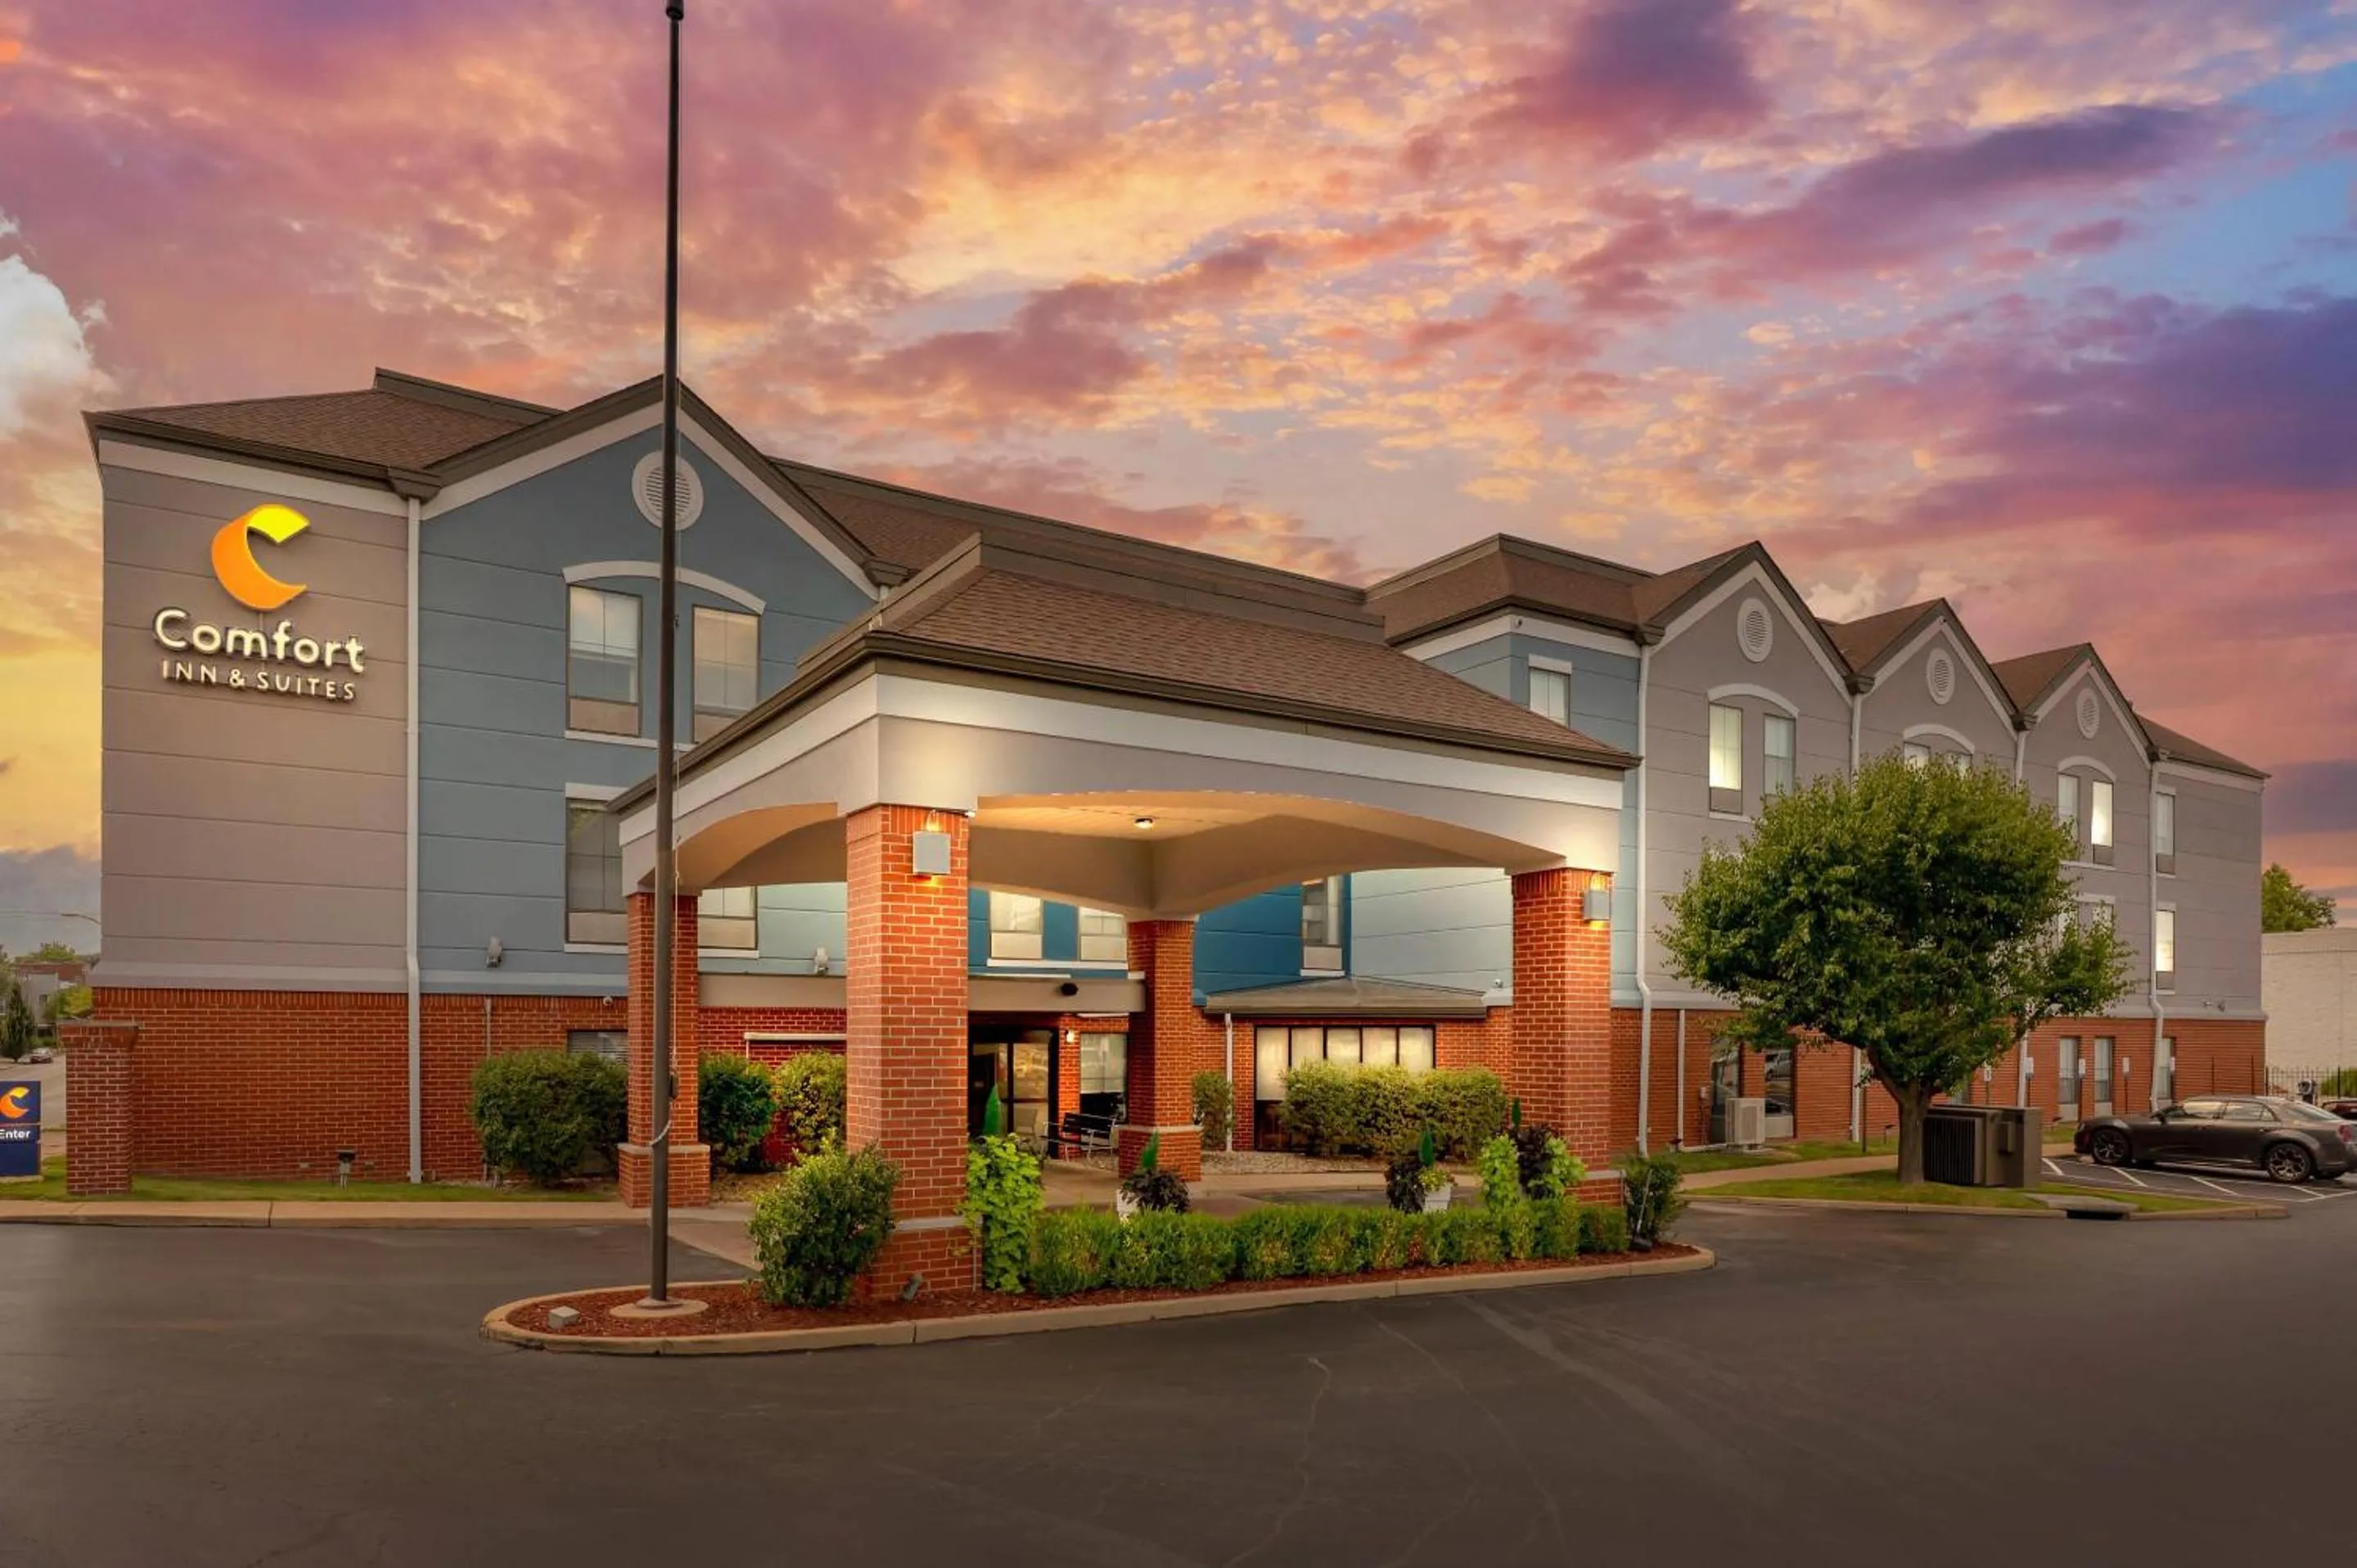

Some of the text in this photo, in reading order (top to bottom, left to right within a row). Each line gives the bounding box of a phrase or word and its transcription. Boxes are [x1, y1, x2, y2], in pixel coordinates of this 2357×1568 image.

[154, 608, 365, 673] Comfort
[162, 660, 355, 701] INN & SUITES
[0, 1129, 31, 1139] Enter
